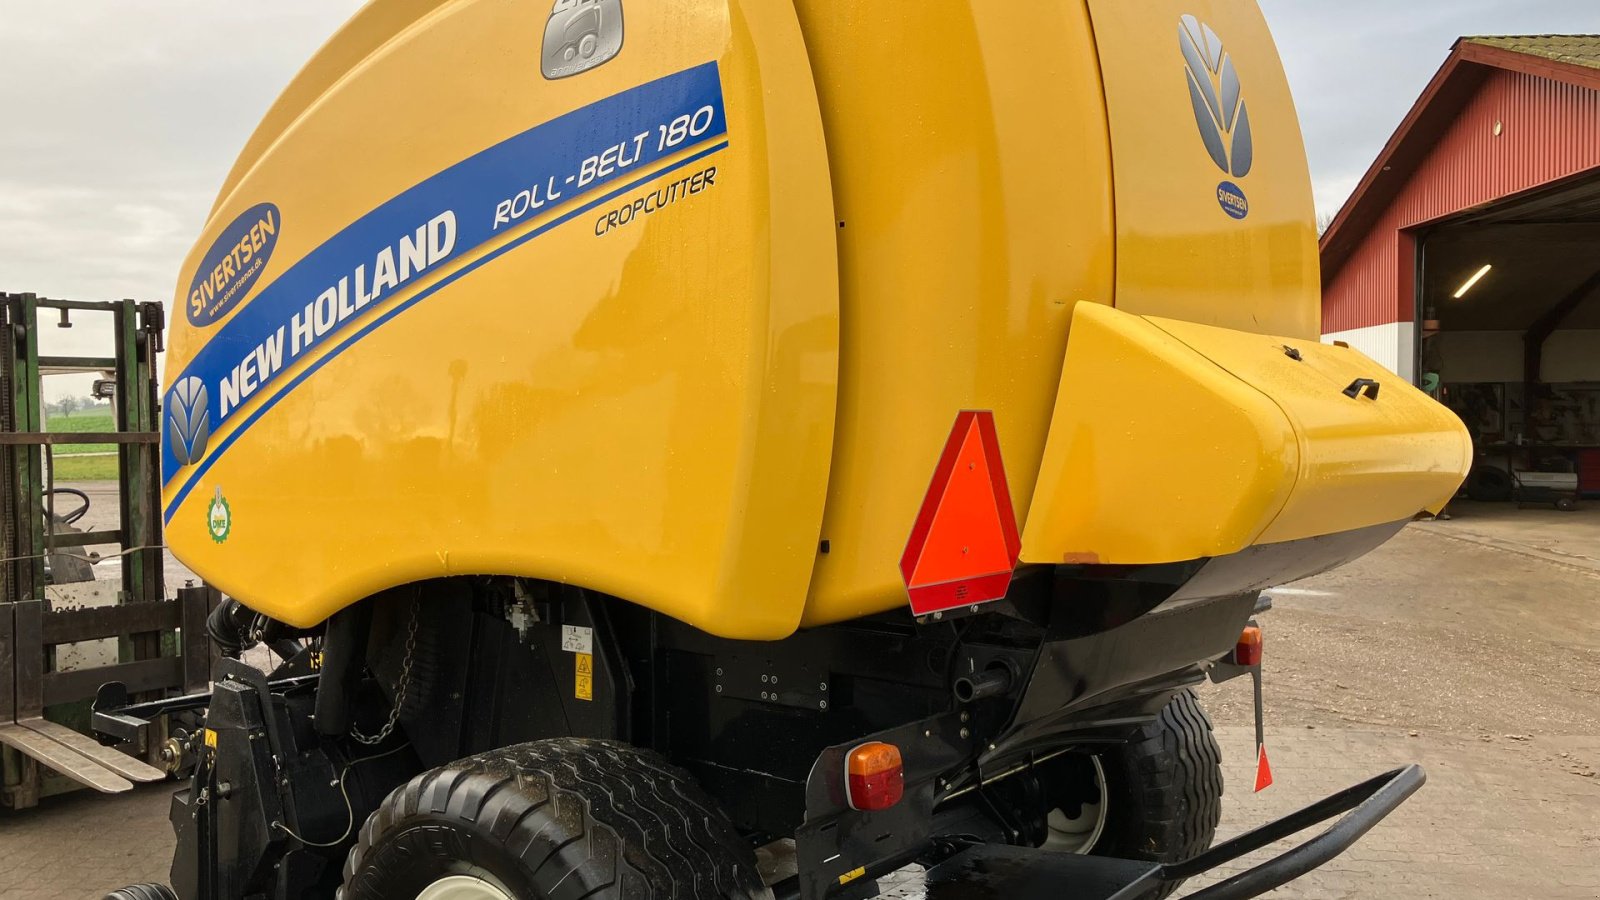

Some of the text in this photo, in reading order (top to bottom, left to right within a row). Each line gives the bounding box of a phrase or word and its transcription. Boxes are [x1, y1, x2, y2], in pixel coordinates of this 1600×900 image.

[657, 104, 714, 152] 180
[594, 166, 717, 236] CROPCUTTER
[191, 209, 275, 318] SIVERTSEN
[219, 209, 457, 418] NEW HOLLAND
